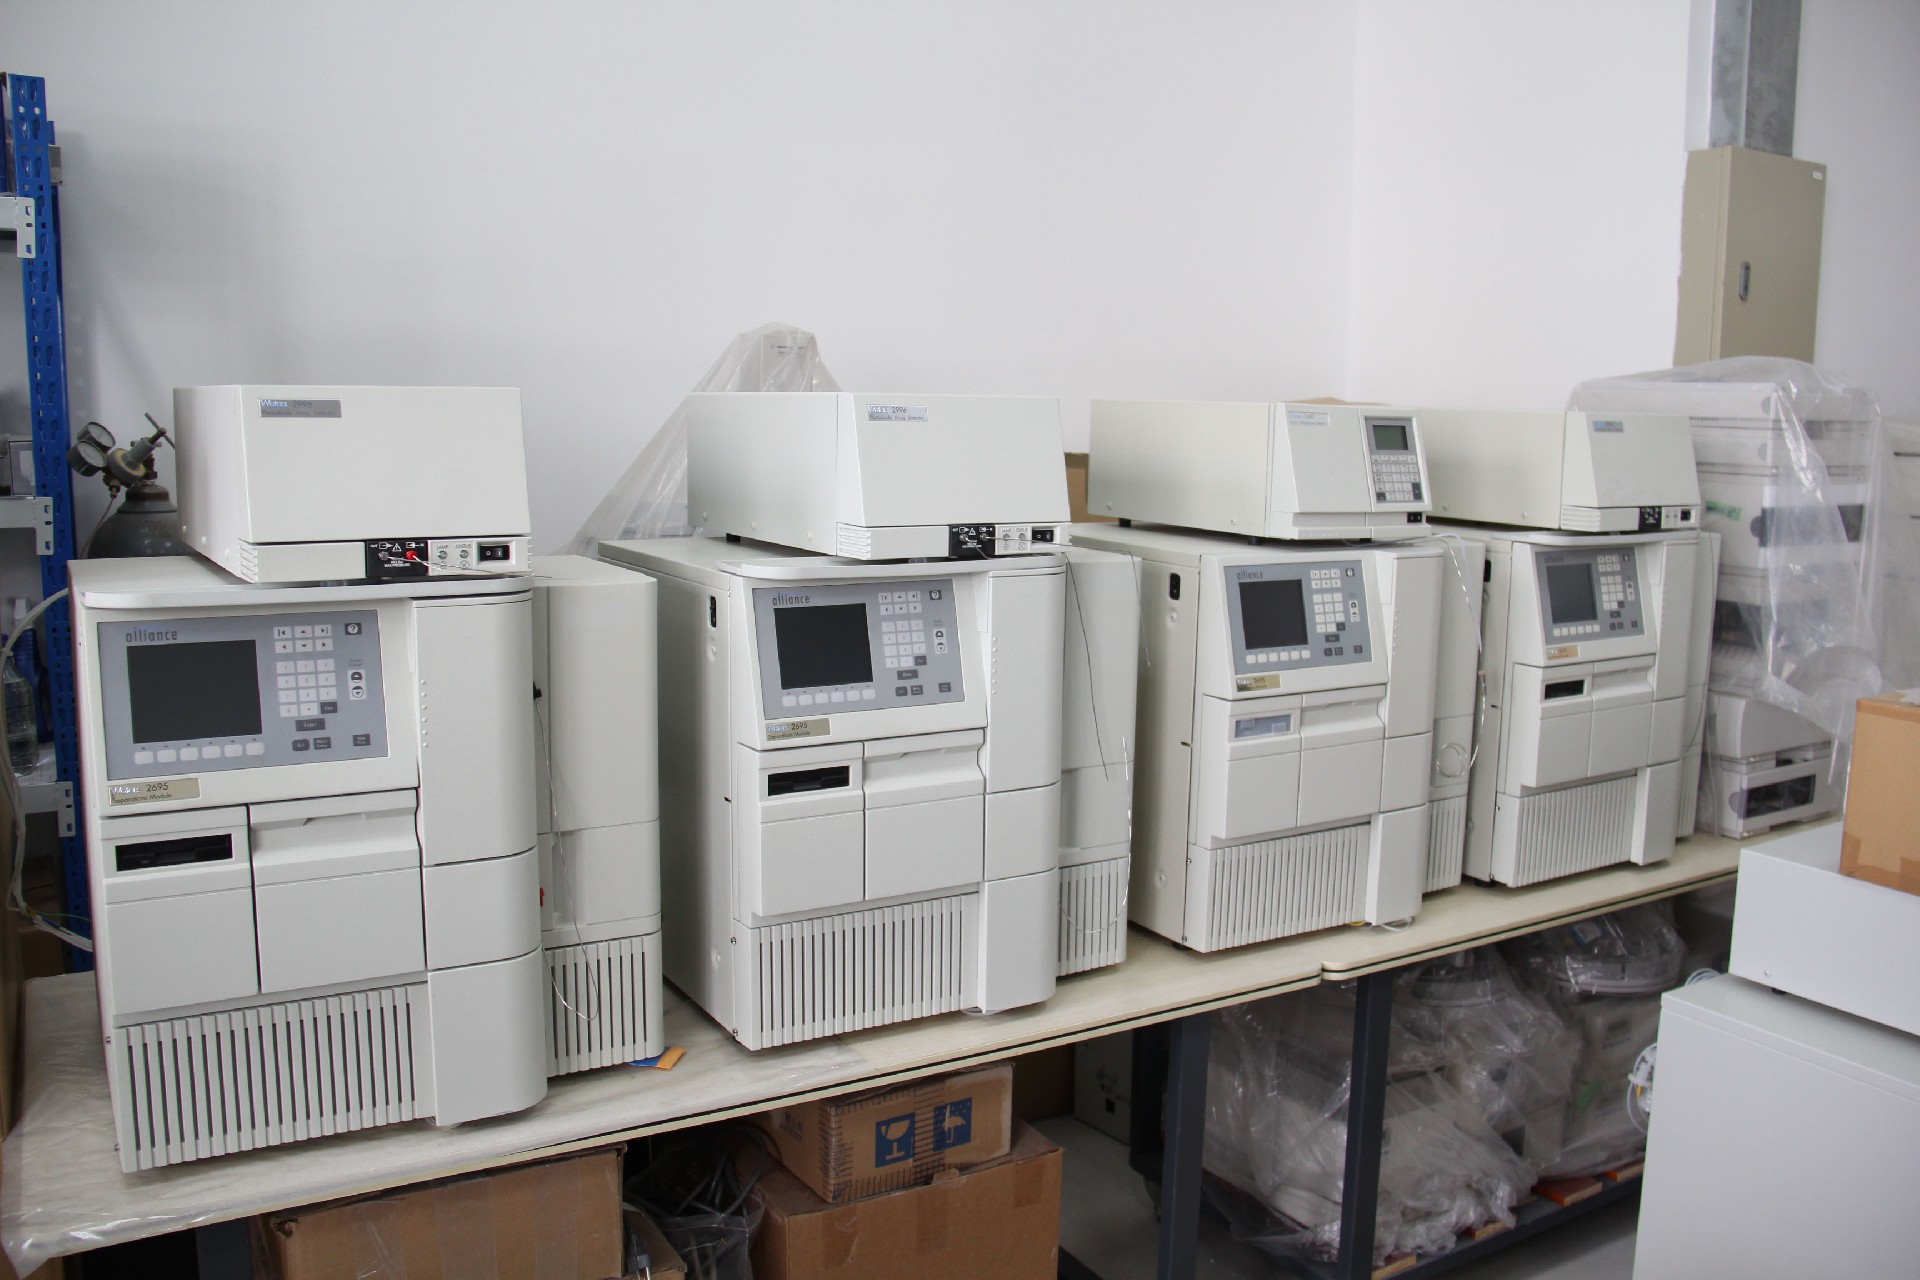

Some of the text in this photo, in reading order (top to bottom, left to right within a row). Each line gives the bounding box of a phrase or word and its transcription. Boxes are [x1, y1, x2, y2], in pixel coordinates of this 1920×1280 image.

[892, 406, 908, 414] 2996
[772, 592, 811, 605] alliance
[126, 627, 178, 643] alliance
[791, 722, 808, 730] 2695
[146, 782, 169, 792] 2695
[112, 792, 172, 804] Separations Module
